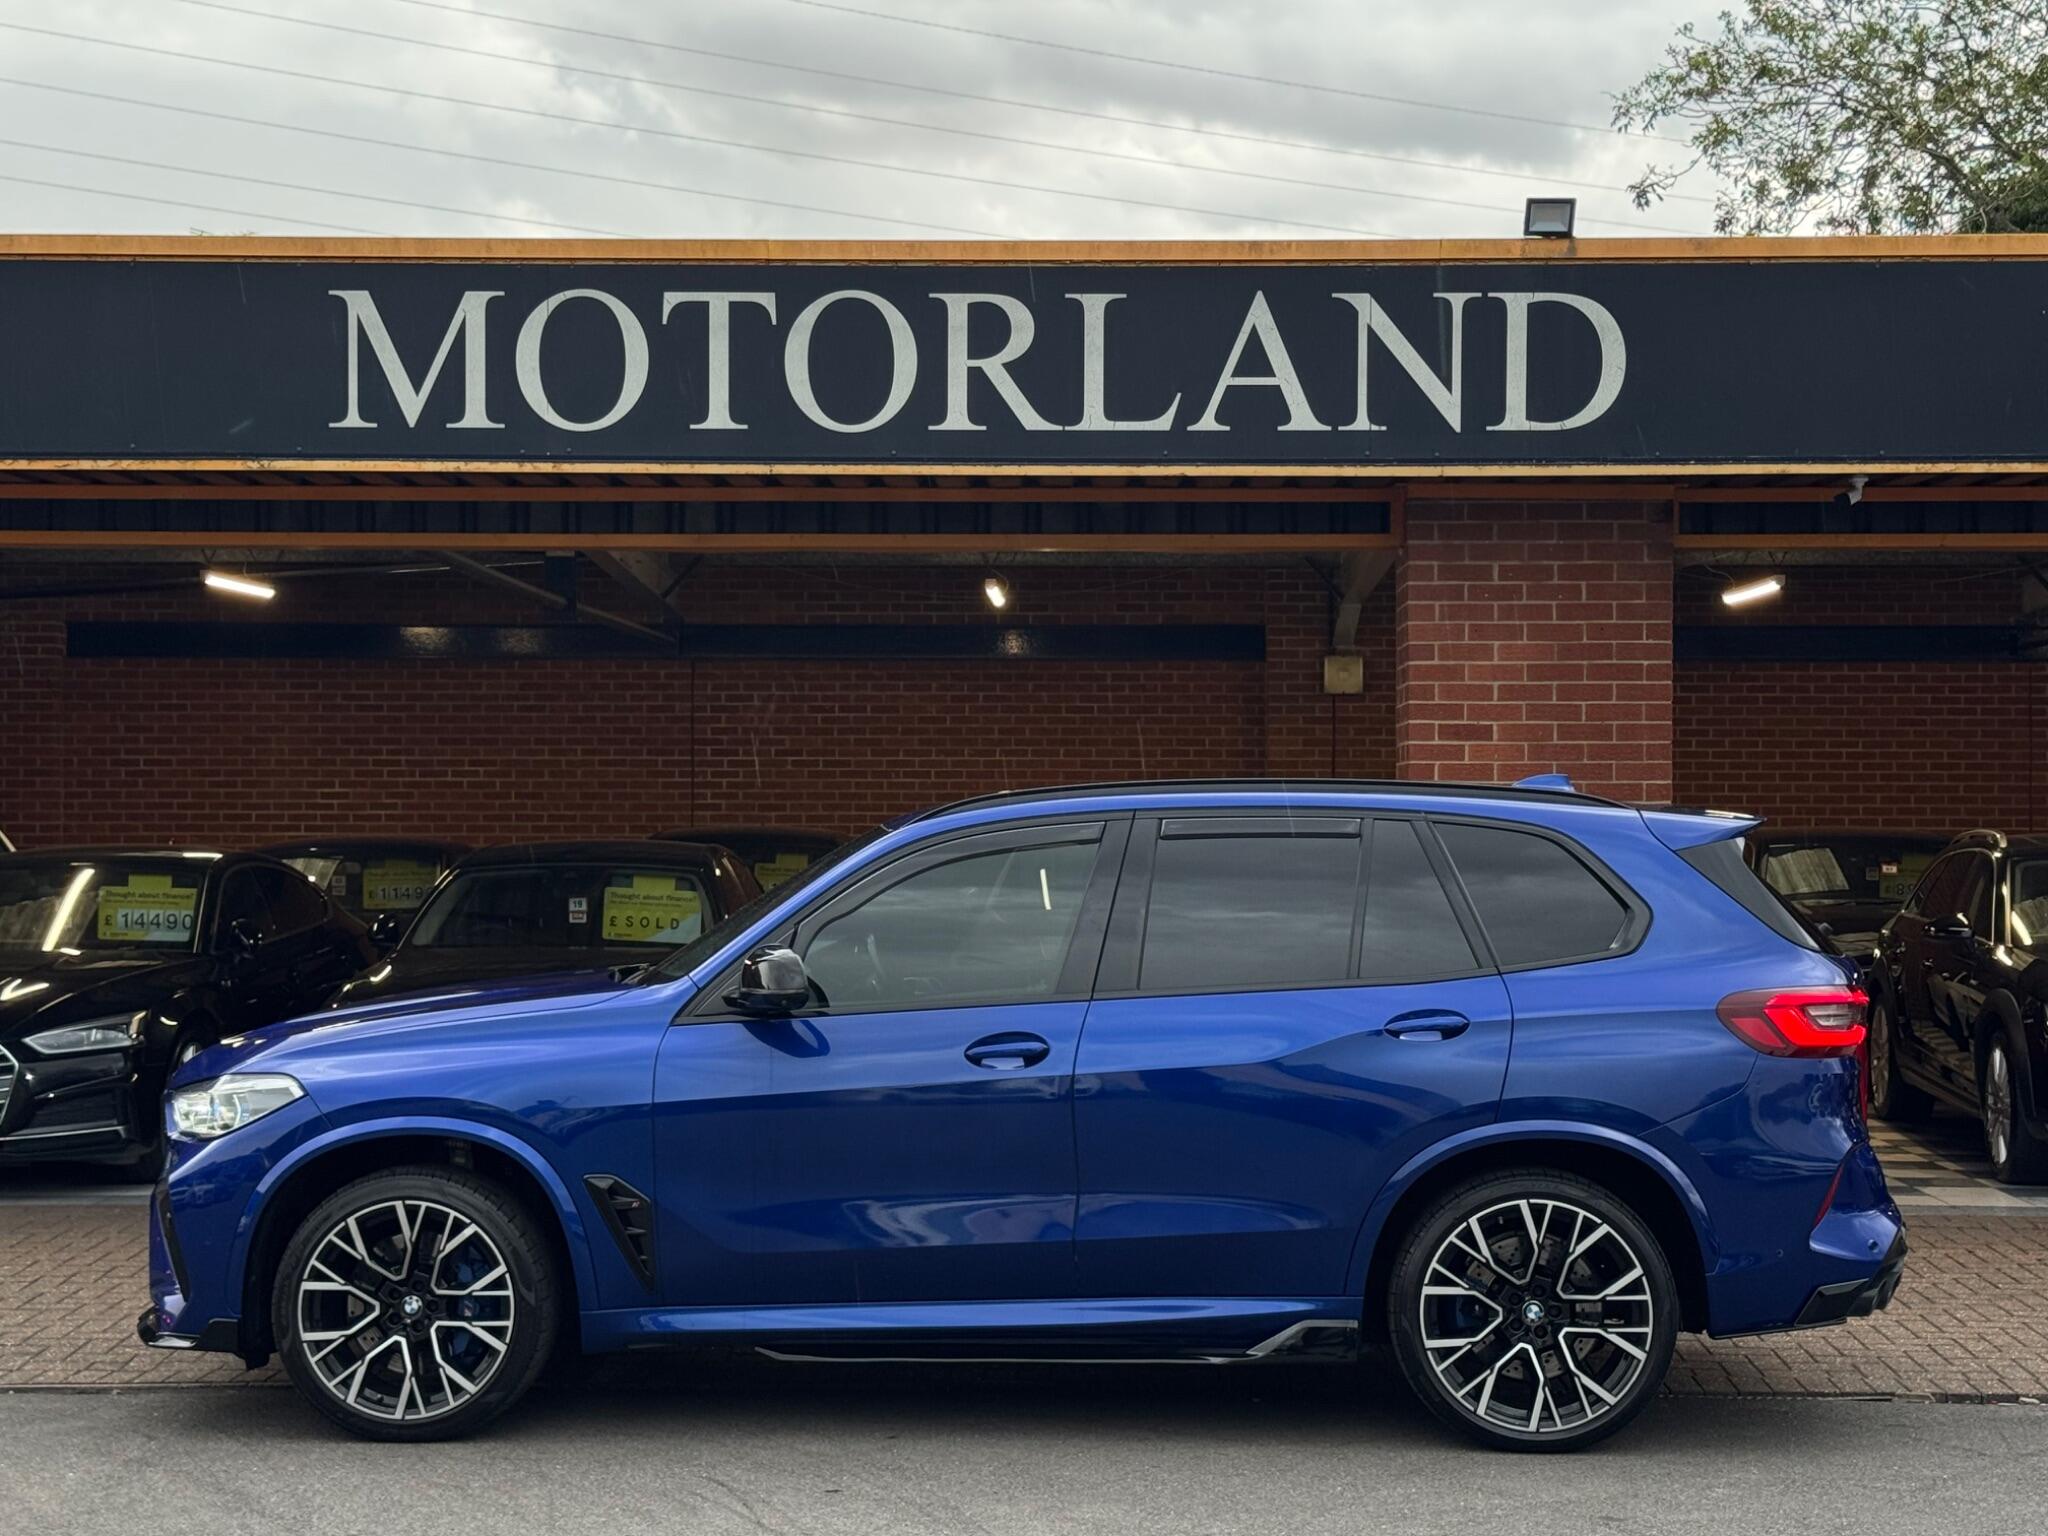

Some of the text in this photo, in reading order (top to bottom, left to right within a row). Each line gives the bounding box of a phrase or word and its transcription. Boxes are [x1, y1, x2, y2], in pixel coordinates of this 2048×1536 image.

[328, 288, 1627, 433] MOTORLAND
[104, 912, 193, 930] £ 14490
[609, 915, 680, 930] £ SOLD
